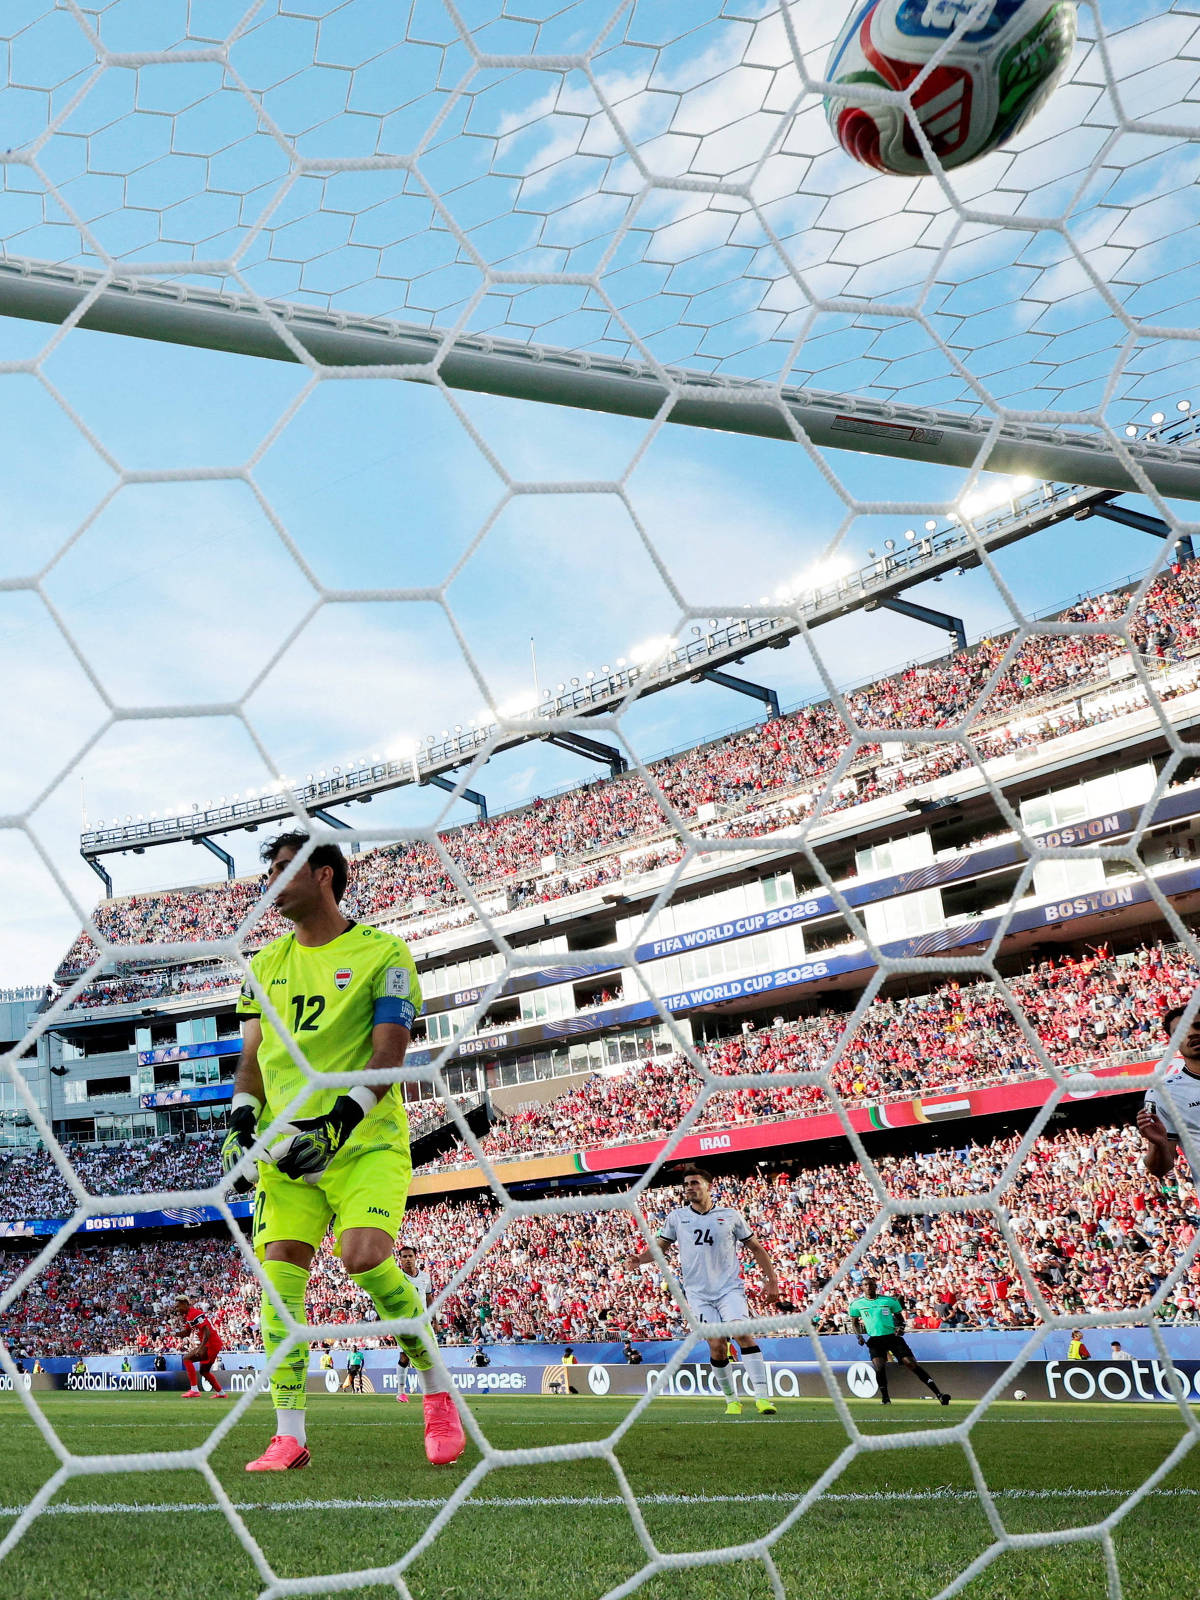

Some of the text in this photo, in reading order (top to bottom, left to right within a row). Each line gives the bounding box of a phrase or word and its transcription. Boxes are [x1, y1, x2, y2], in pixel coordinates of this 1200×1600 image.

[1034, 816, 1120, 848] BOSTON
[1044, 887, 1133, 921] BOSTON
[653, 901, 819, 955] FIFA WORLD CUP 2026
[271, 978, 287, 986] AKO
[660, 962, 828, 1011] FIFA WORLD CUP 2026
[291, 995, 326, 1033] 12
[459, 1034, 508, 1055] BOSTON
[699, 1134, 731, 1150] IRAQ
[367, 1206, 390, 1218] JAKO
[86, 1216, 135, 1230] BOSTON
[693, 1229, 714, 1246] 24
[67, 1371, 157, 1393] football is calling
[476, 1372, 523, 1389] 2026
[1045, 1360, 1200, 1401] footb
